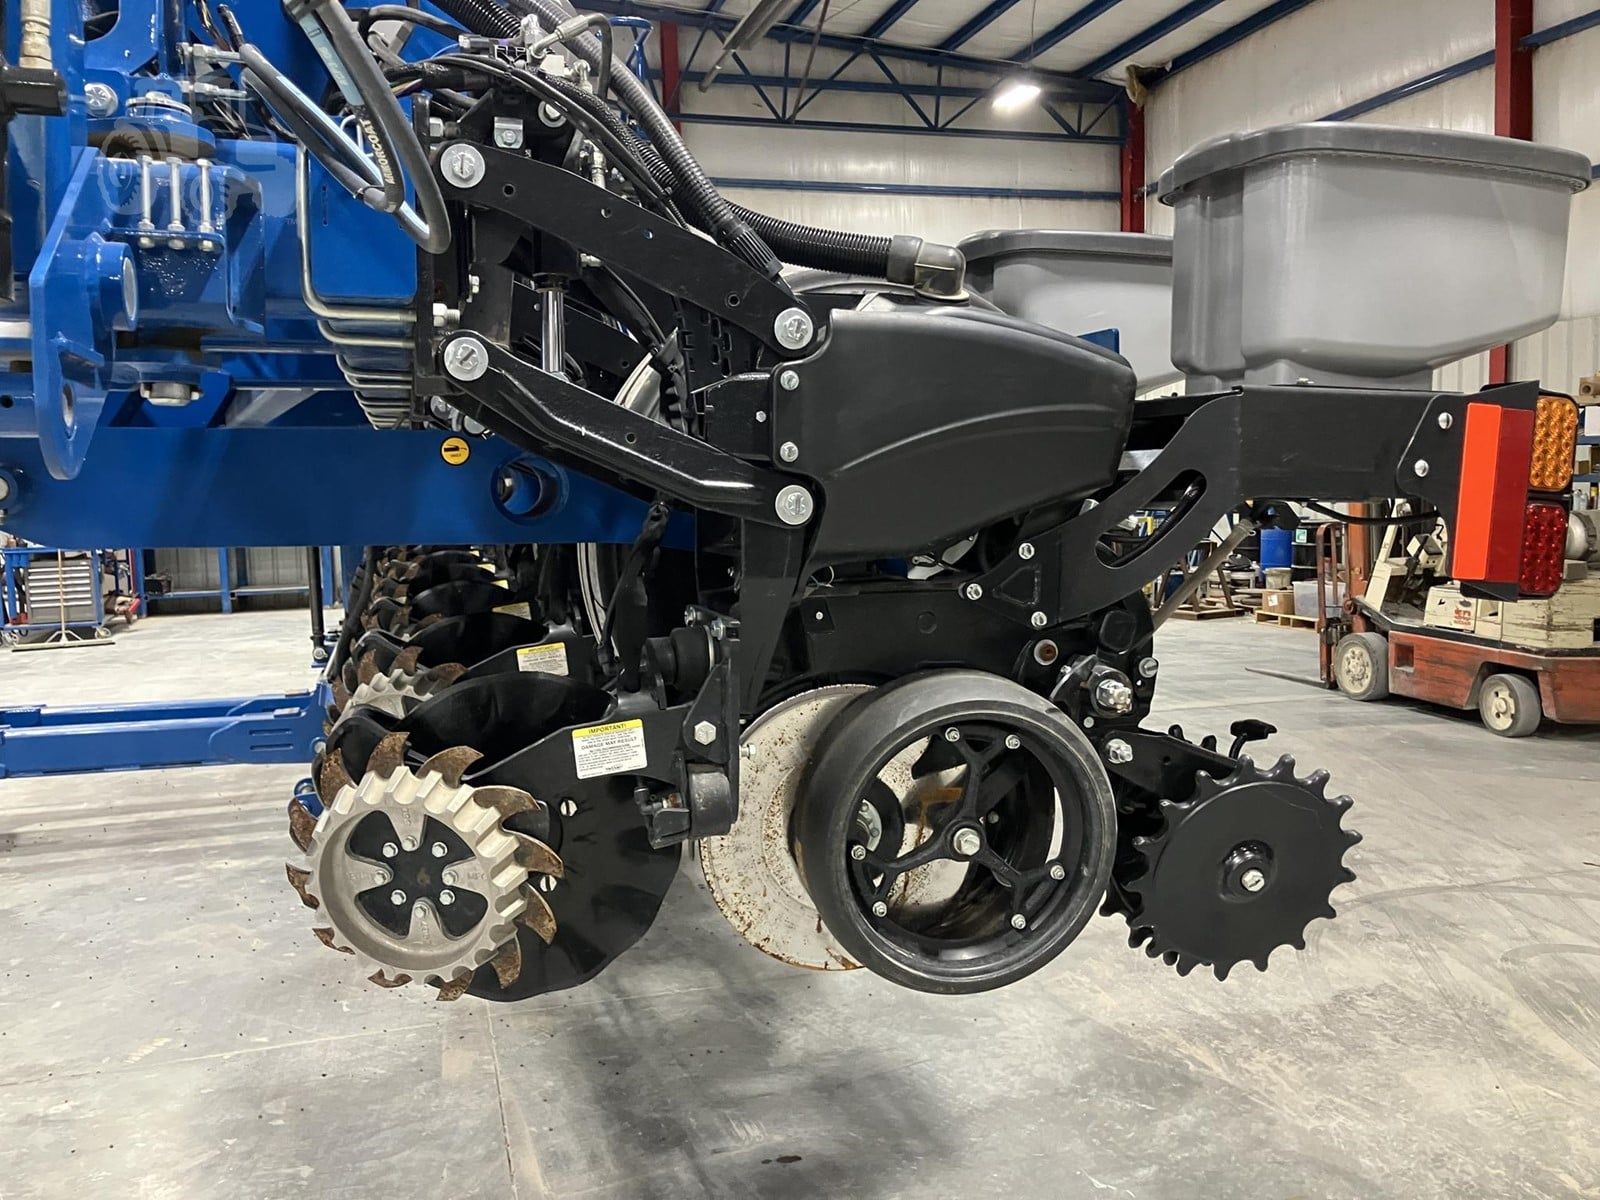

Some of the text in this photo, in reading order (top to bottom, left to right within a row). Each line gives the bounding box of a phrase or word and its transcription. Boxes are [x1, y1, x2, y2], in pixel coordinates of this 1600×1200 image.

[359, 119, 396, 184] ARMORCOAT
[588, 723, 627, 734] IMPORTANT!
[580, 743, 604, 751] DAMAGE
[617, 736, 637, 744] RESULT
